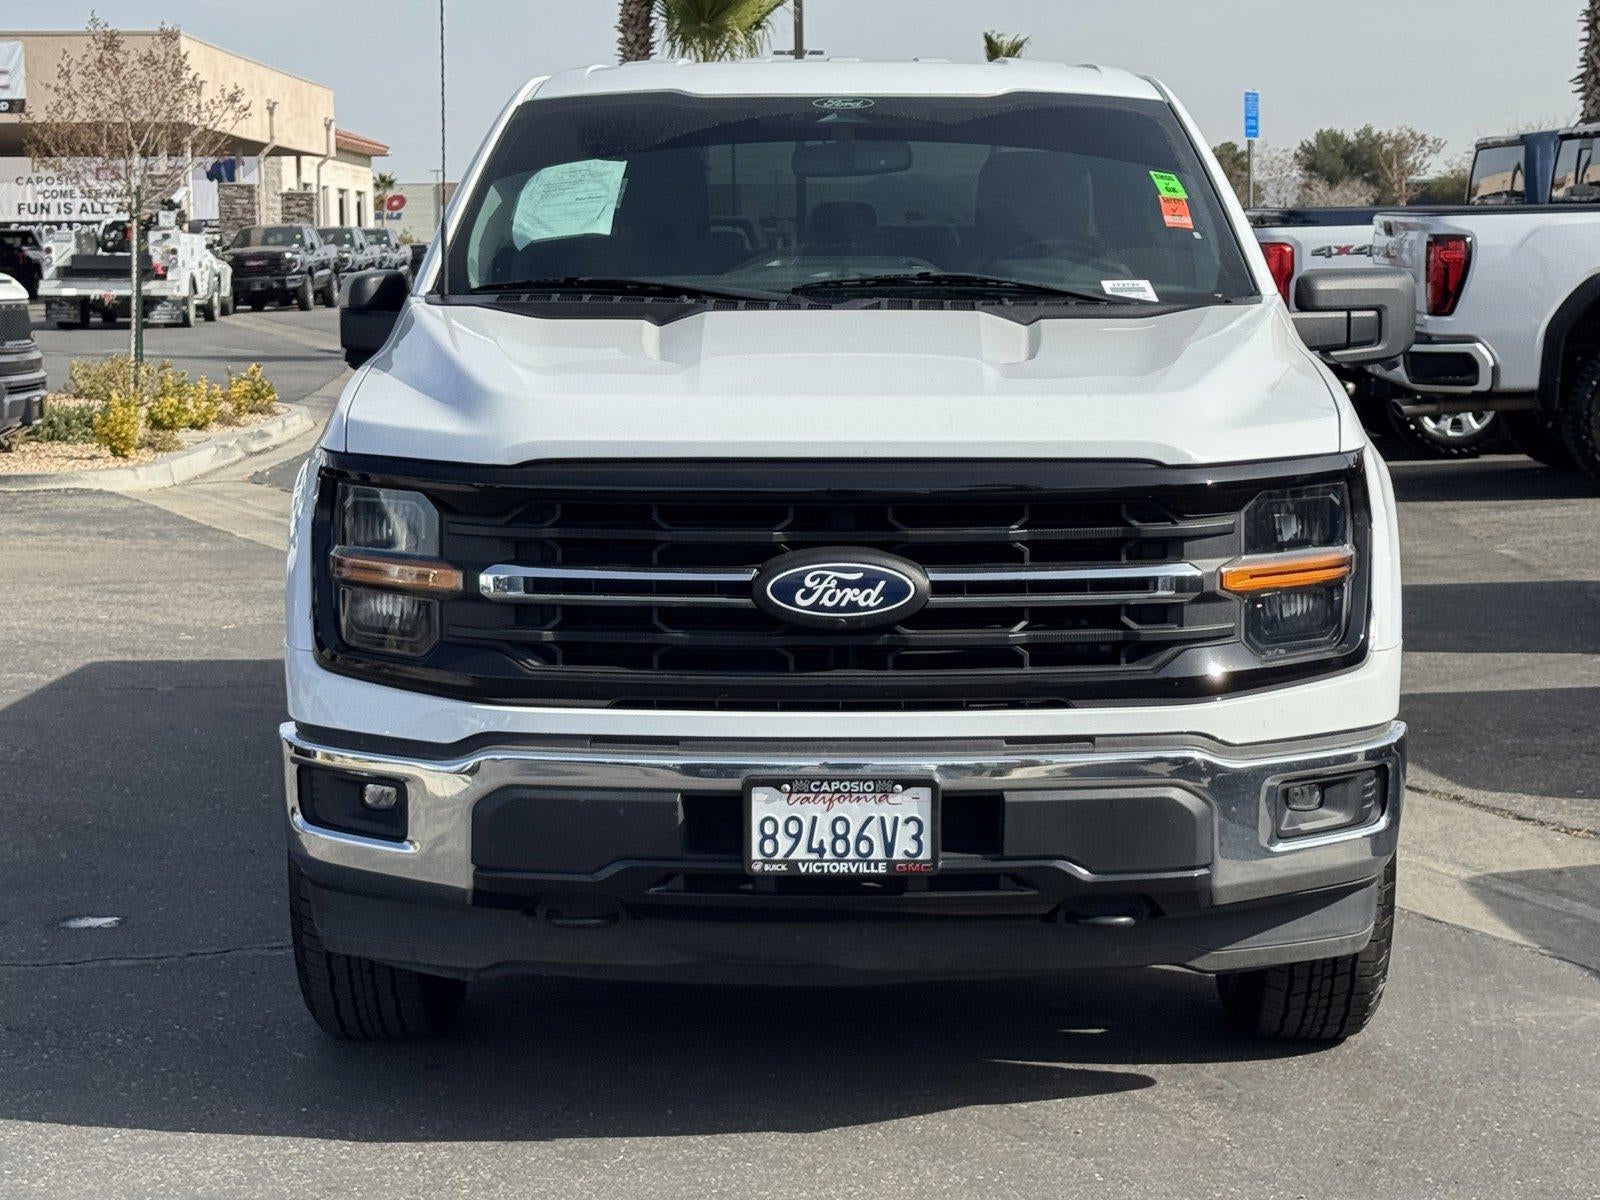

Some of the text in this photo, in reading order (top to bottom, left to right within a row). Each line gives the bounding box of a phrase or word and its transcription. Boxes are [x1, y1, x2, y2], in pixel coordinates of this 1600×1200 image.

[17, 203, 51, 215] FUN
[58, 203, 73, 215] IS
[79, 202, 111, 215] ALL
[795, 570, 887, 607] Ford
[809, 780, 875, 793] CAPOSIO
[786, 792, 903, 813] California
[759, 815, 925, 860] 89486V3
[763, 861, 934, 874] BUICK VICTORVILLE GMC
